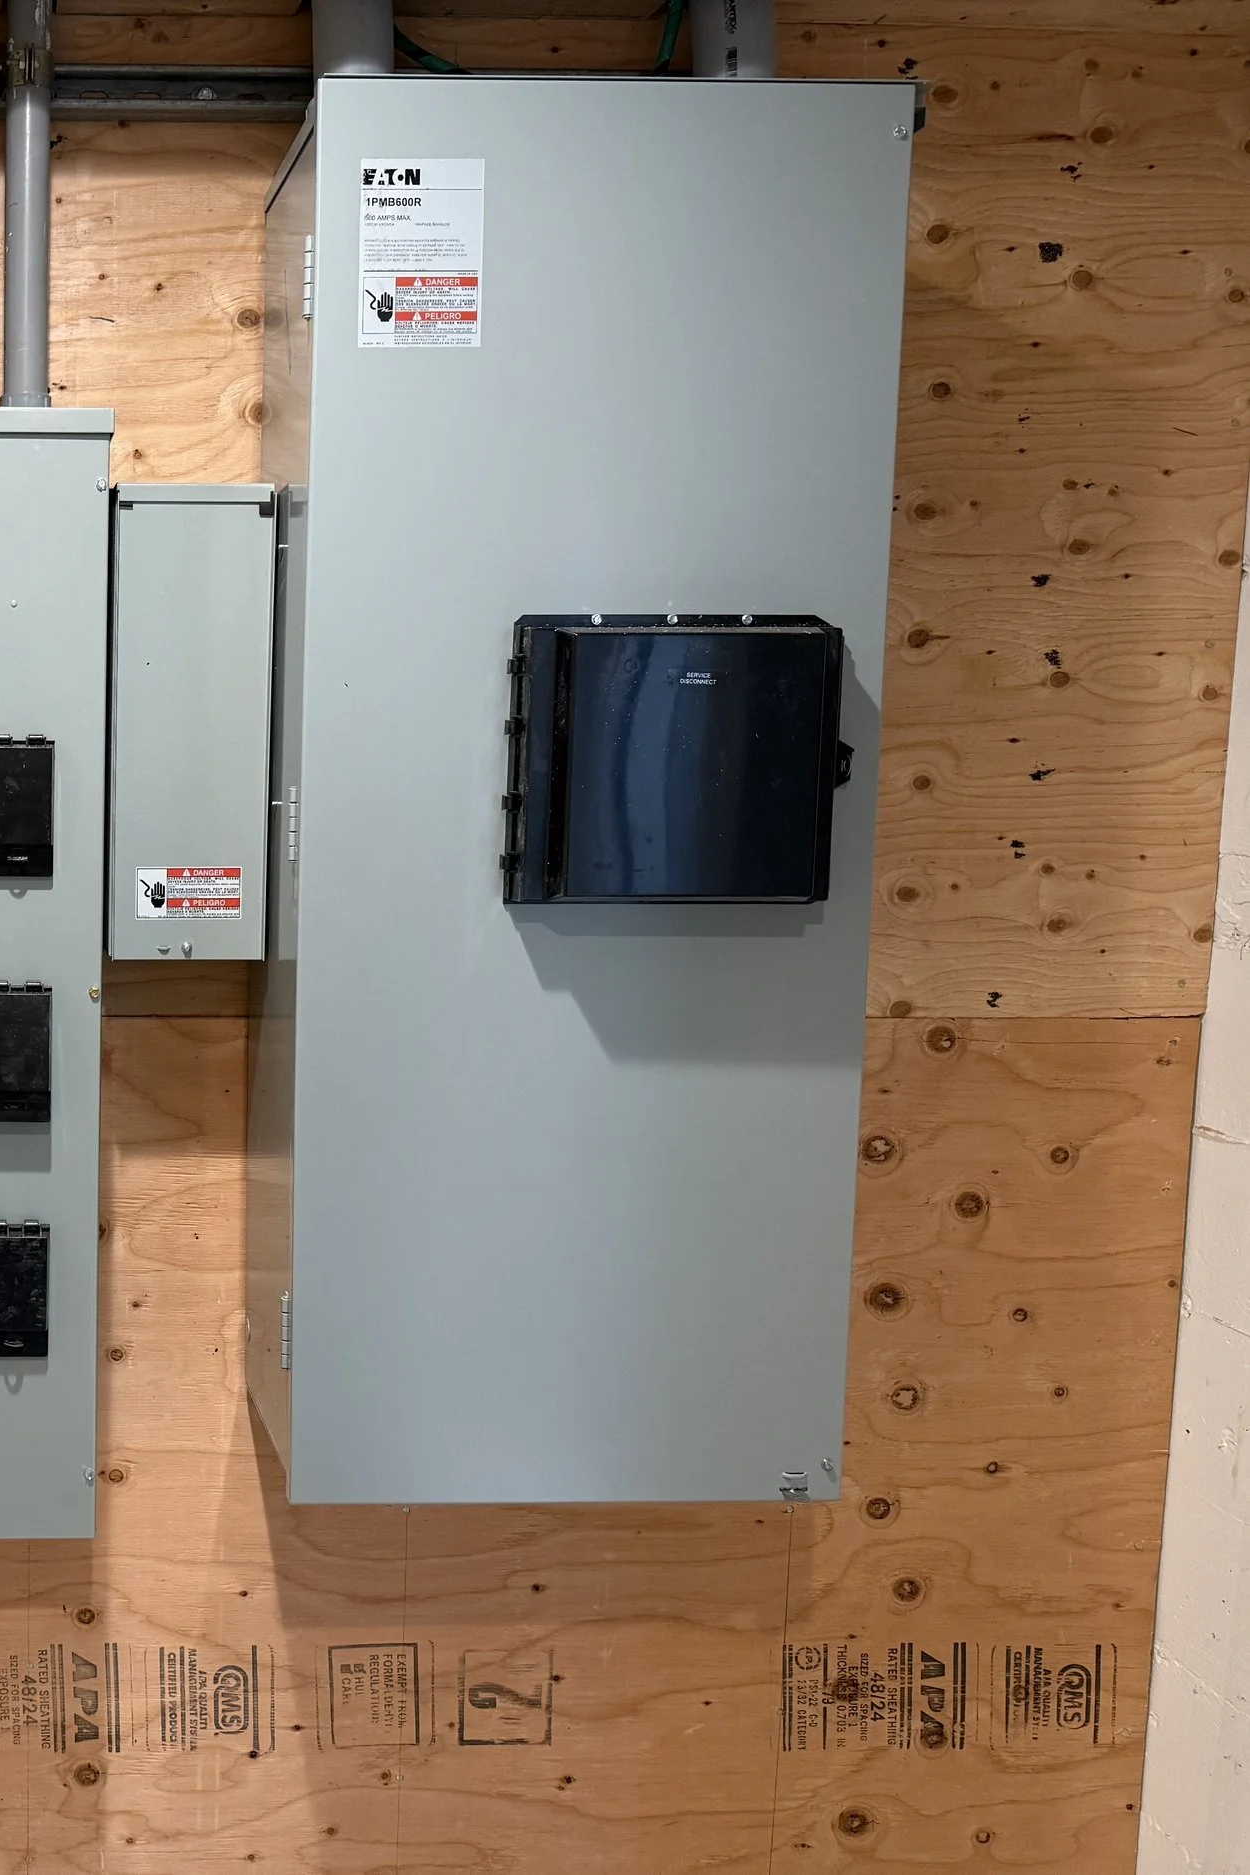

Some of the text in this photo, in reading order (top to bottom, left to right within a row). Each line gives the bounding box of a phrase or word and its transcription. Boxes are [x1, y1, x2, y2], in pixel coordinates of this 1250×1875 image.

[363, 169, 420, 185] EATON
[366, 197, 422, 207] 1PMB600R
[188, 1648, 198, 1714] MANAGEMENT
[397, 1653, 407, 1693] EXEMPT
[837, 1644, 847, 1699] THICKNESS
[860, 1653, 868, 1677] SIZED
[1033, 1647, 1043, 1714] MANAGEMENT
[10, 1655, 21, 1745] SIZED FOR SPACING
[21, 1675, 38, 1726] 48/24
[38, 1649, 51, 1749] RATED SHEATHING
[71, 1651, 99, 1743] APA
[220, 1672, 242, 1728] QMS
[822, 1692, 835, 1704] 79
[837, 1705, 846, 1733] 0.703
[860, 1704, 868, 1741] SPACING
[870, 1673, 885, 1721] 48/24
[887, 1648, 898, 1745] RATED SHEATHING
[1063, 1671, 1084, 1725] QMS
